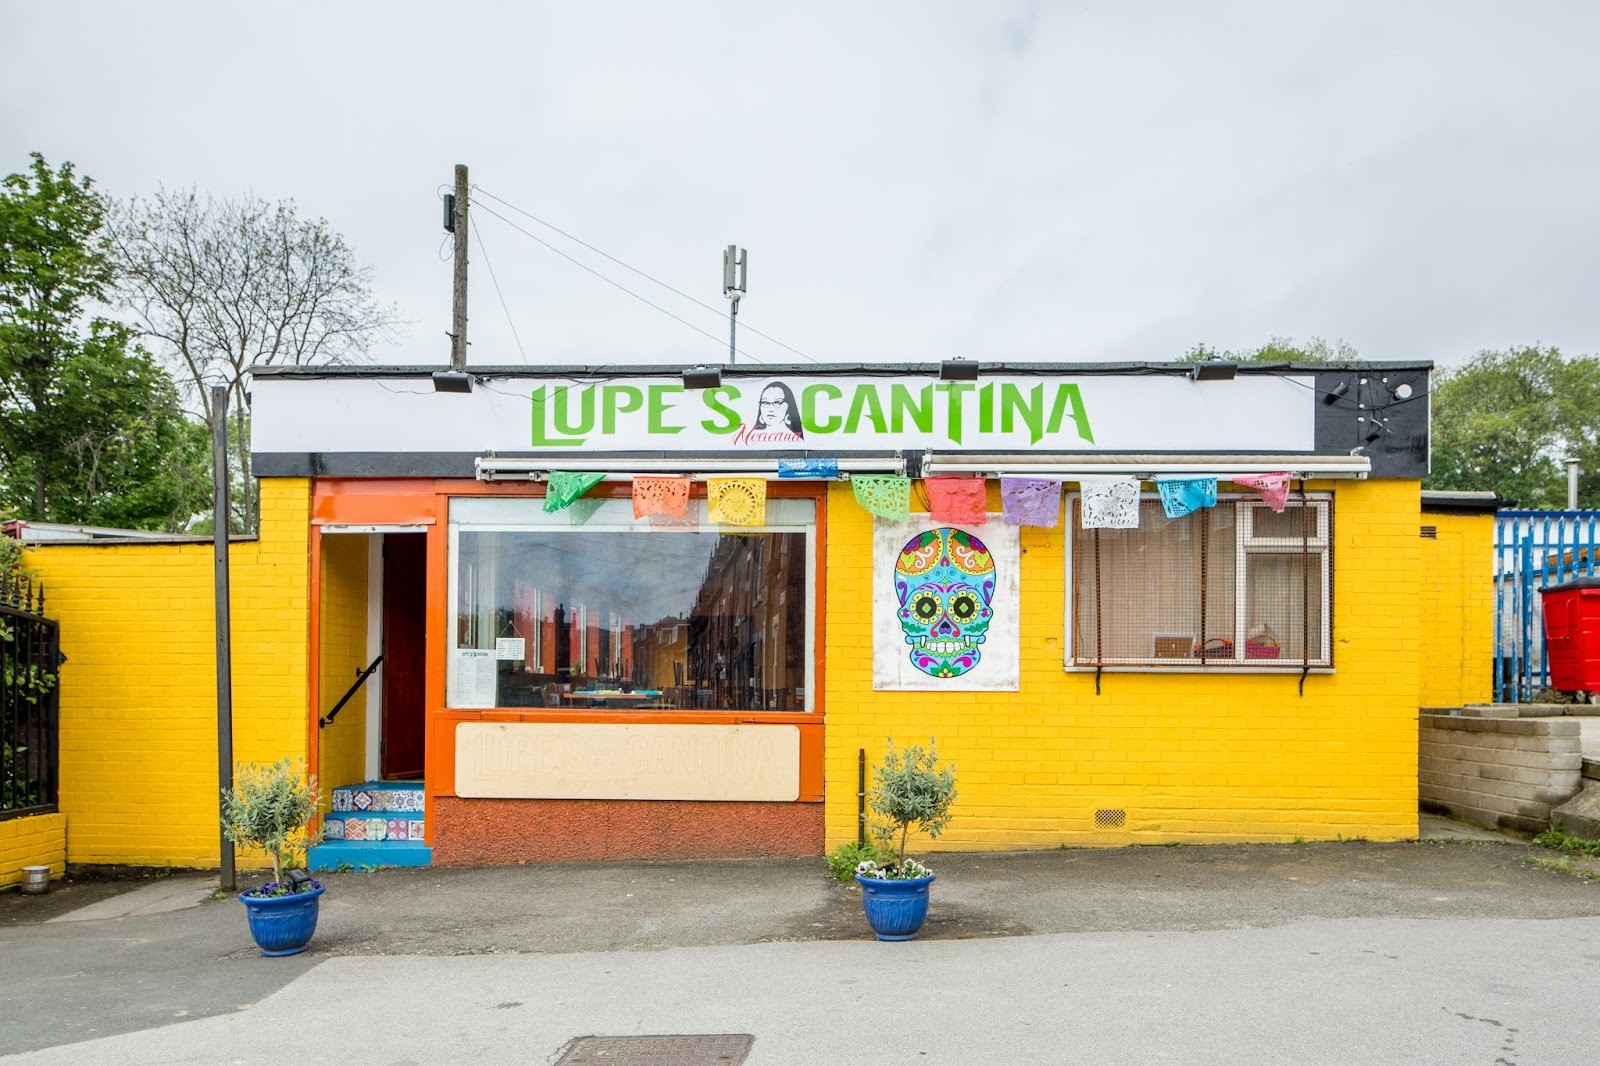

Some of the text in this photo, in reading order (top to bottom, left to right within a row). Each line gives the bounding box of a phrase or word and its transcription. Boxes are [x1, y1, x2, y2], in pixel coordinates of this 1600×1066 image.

[532, 381, 1096, 446] LUPES CANTINA
[733, 422, 802, 446] Mexicana
